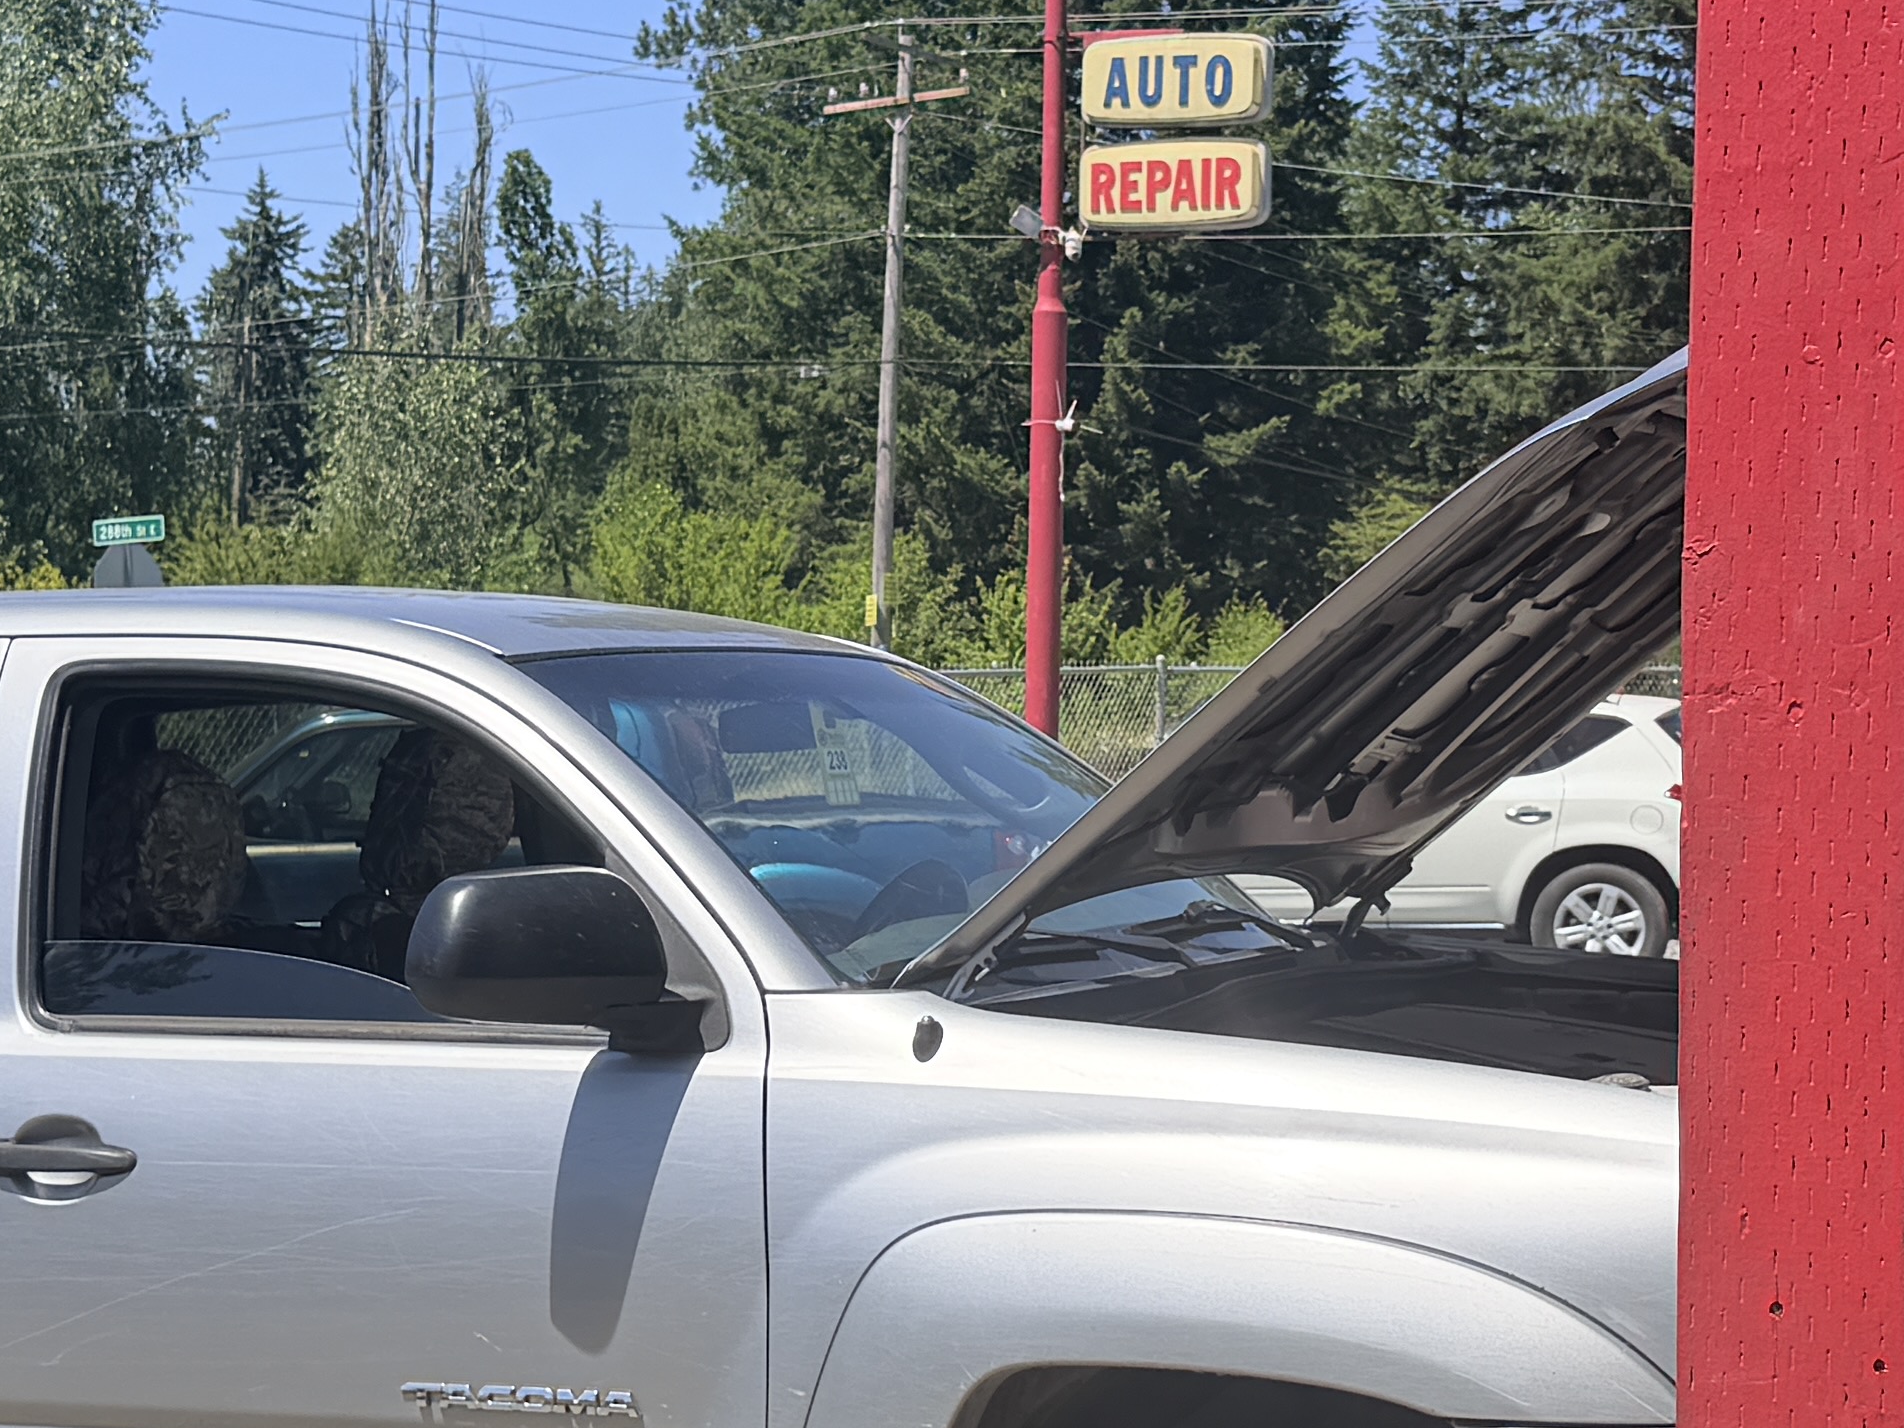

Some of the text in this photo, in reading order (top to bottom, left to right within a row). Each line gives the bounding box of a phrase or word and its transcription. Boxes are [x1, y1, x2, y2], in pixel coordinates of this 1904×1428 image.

[1103, 54, 1233, 109] AUTO
[1090, 157, 1242, 215] REPAIR
[400, 1381, 641, 1419] TACOMA
